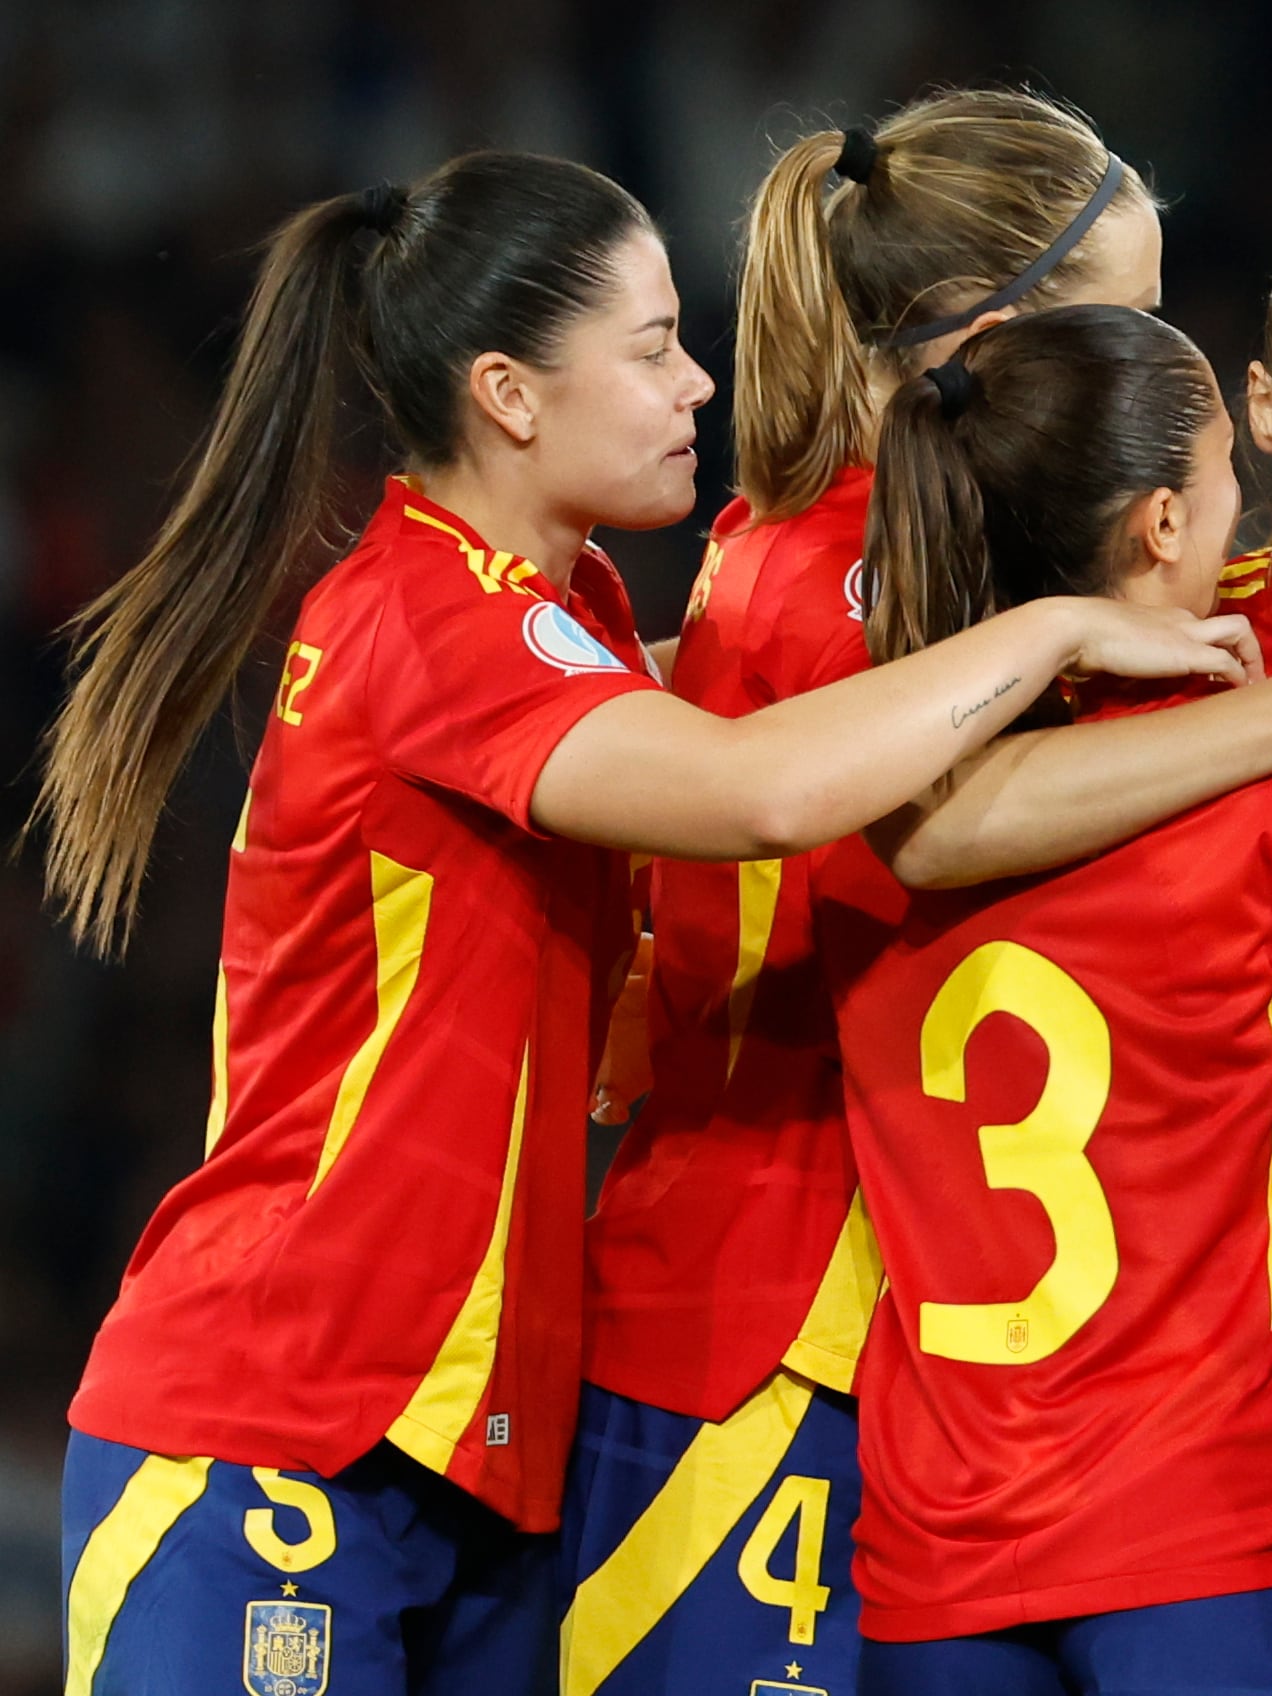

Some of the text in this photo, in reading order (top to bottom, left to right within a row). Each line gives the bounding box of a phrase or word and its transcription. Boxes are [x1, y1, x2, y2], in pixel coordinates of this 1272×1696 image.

[919, 940, 1120, 1366] 3
[243, 1465, 337, 1574] 5
[737, 1474, 831, 1646] 4
